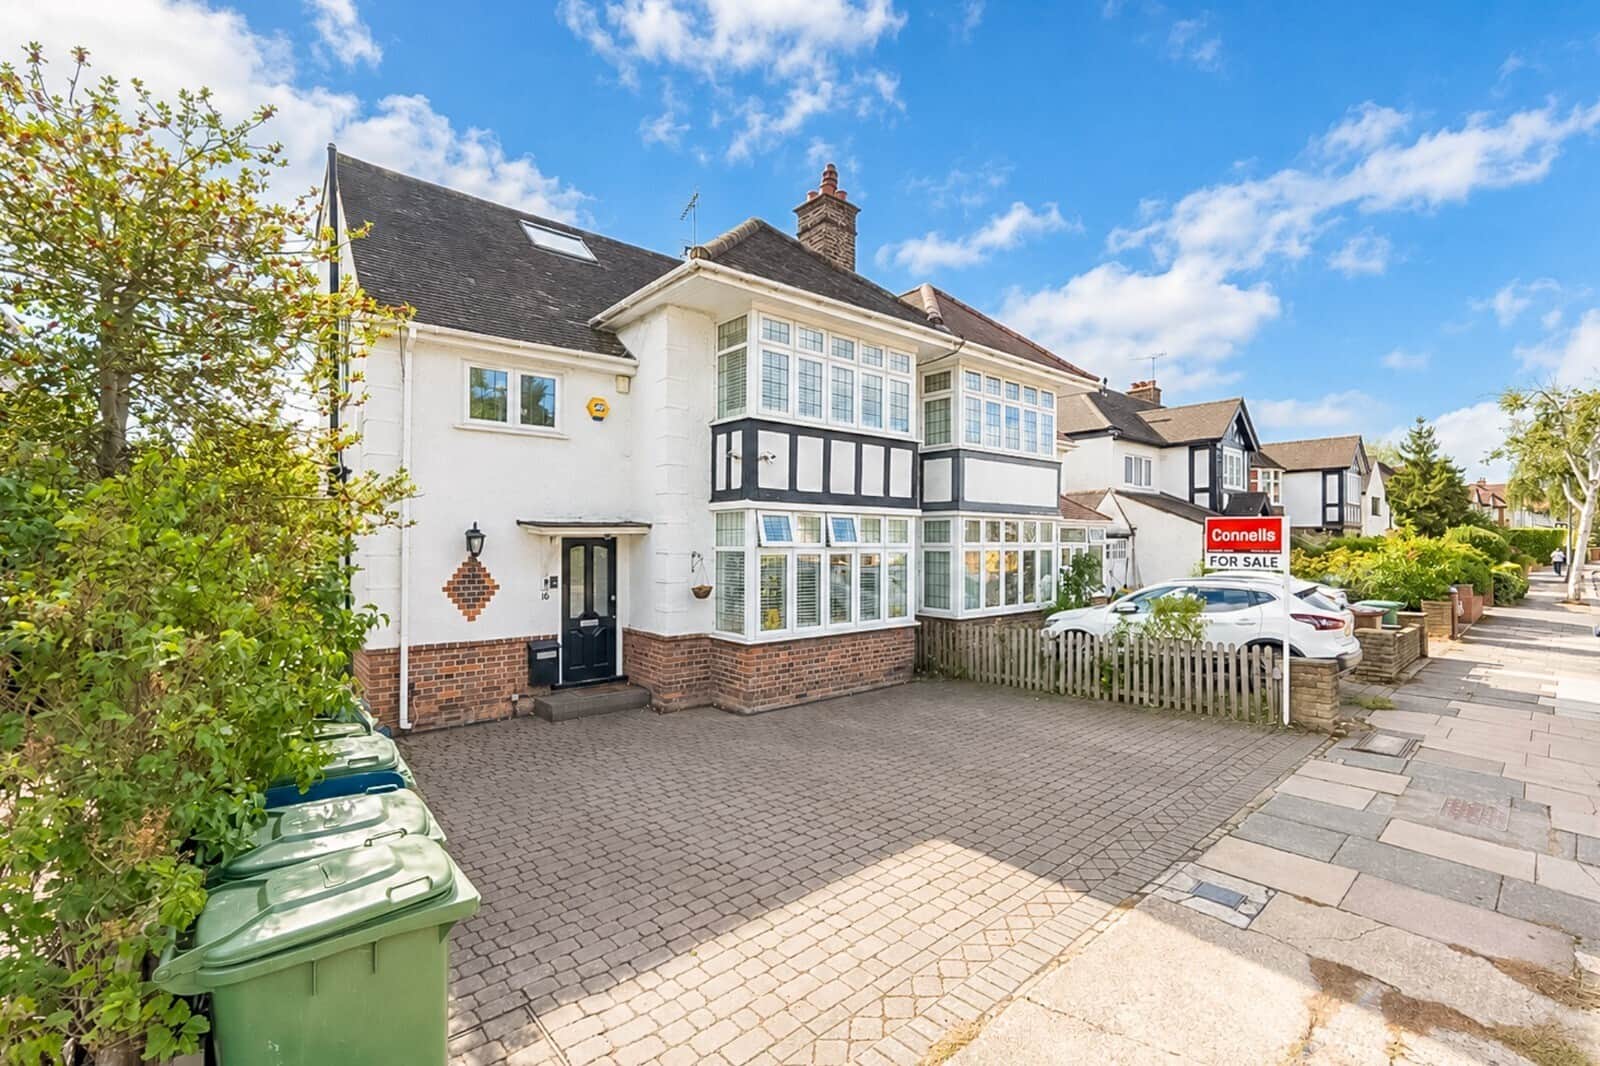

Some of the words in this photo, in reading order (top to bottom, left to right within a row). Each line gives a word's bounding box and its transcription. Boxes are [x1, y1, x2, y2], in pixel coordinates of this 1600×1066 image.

[1211, 528, 1276, 542] Connells
[1210, 556, 1238, 567] FOR
[1243, 556, 1278, 568] SALE
